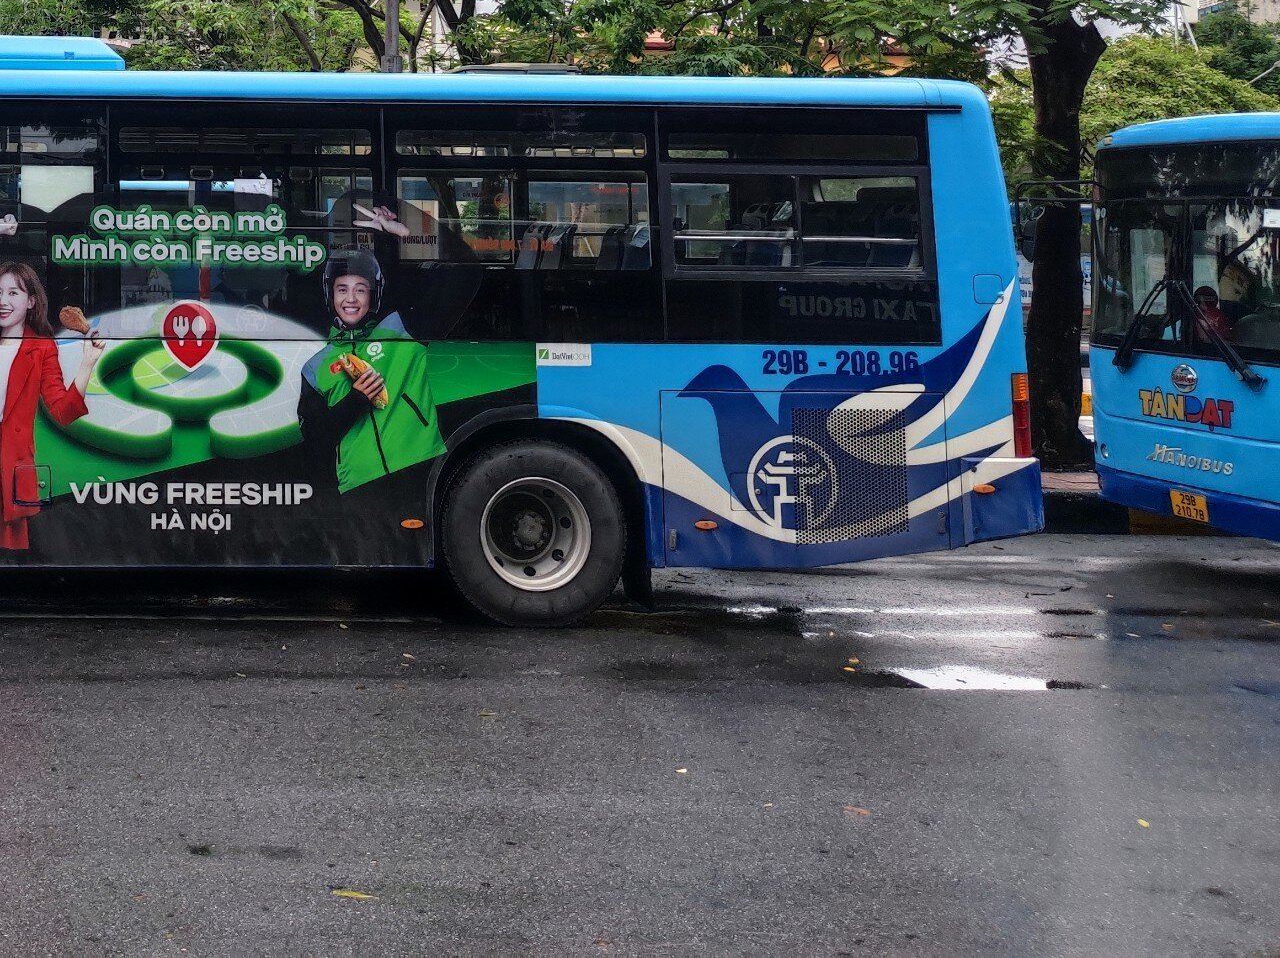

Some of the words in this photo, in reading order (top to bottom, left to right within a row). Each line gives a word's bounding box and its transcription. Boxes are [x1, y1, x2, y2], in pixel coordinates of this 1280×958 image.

[93, 207, 170, 231] Quán
[175, 208, 230, 231] còn
[238, 207, 284, 231] mở
[55, 237, 127, 261] Mình
[133, 237, 188, 261] còn
[196, 238, 323, 268] Freeship
[762, 349, 809, 375] 29B
[836, 350, 920, 376] 208.96
[1146, 443, 1234, 476] HANOIBUS
[69, 475, 159, 505] VÙNG
[166, 482, 314, 506] FREESHIP
[1179, 493, 1198, 507] 29B
[150, 508, 186, 531] HÀ
[190, 509, 232, 535] NỘI
[1175, 504, 1205, 521] 210.78
